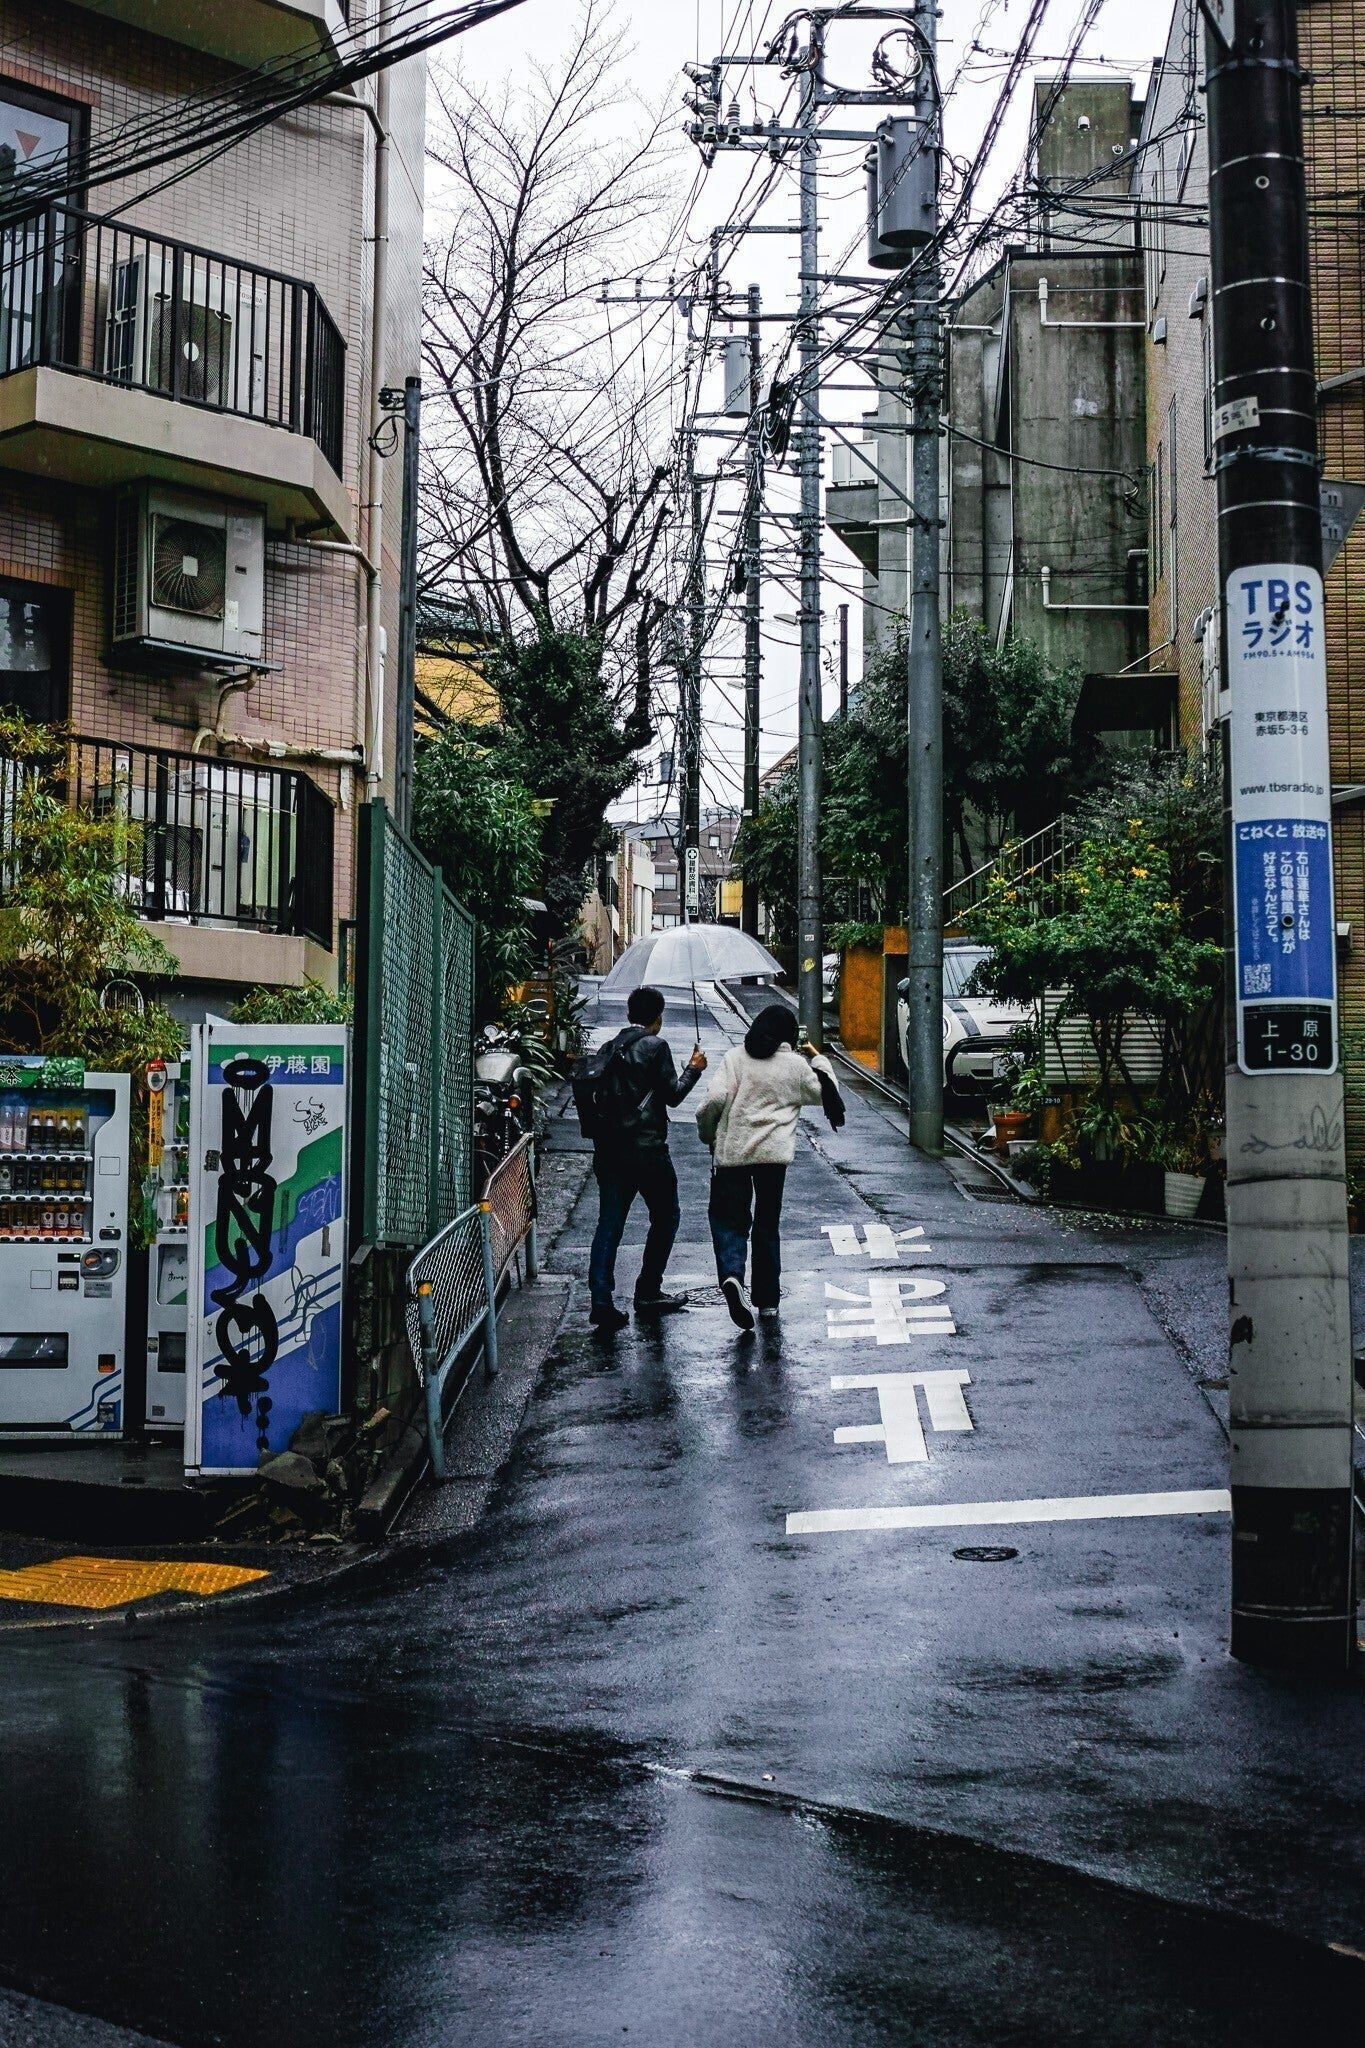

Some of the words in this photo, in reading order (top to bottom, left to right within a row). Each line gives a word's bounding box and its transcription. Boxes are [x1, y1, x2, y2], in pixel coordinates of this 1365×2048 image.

[1240, 579, 1313, 615] TBS
[1242, 620, 1314, 649] ラジオ
[1254, 711, 1309, 723] 東京都港区
[1255, 725, 1309, 737] 赤坂5-3-6
[1239, 782, 1324, 796] www.tbsradio.jp
[1239, 825, 1288, 841] こねくと
[1292, 823, 1327, 841] 放送中
[1261, 1020, 1319, 1039] 上原
[1264, 1044, 1318, 1061] 1-30
[262, 1054, 331, 1075] 伊藤園
